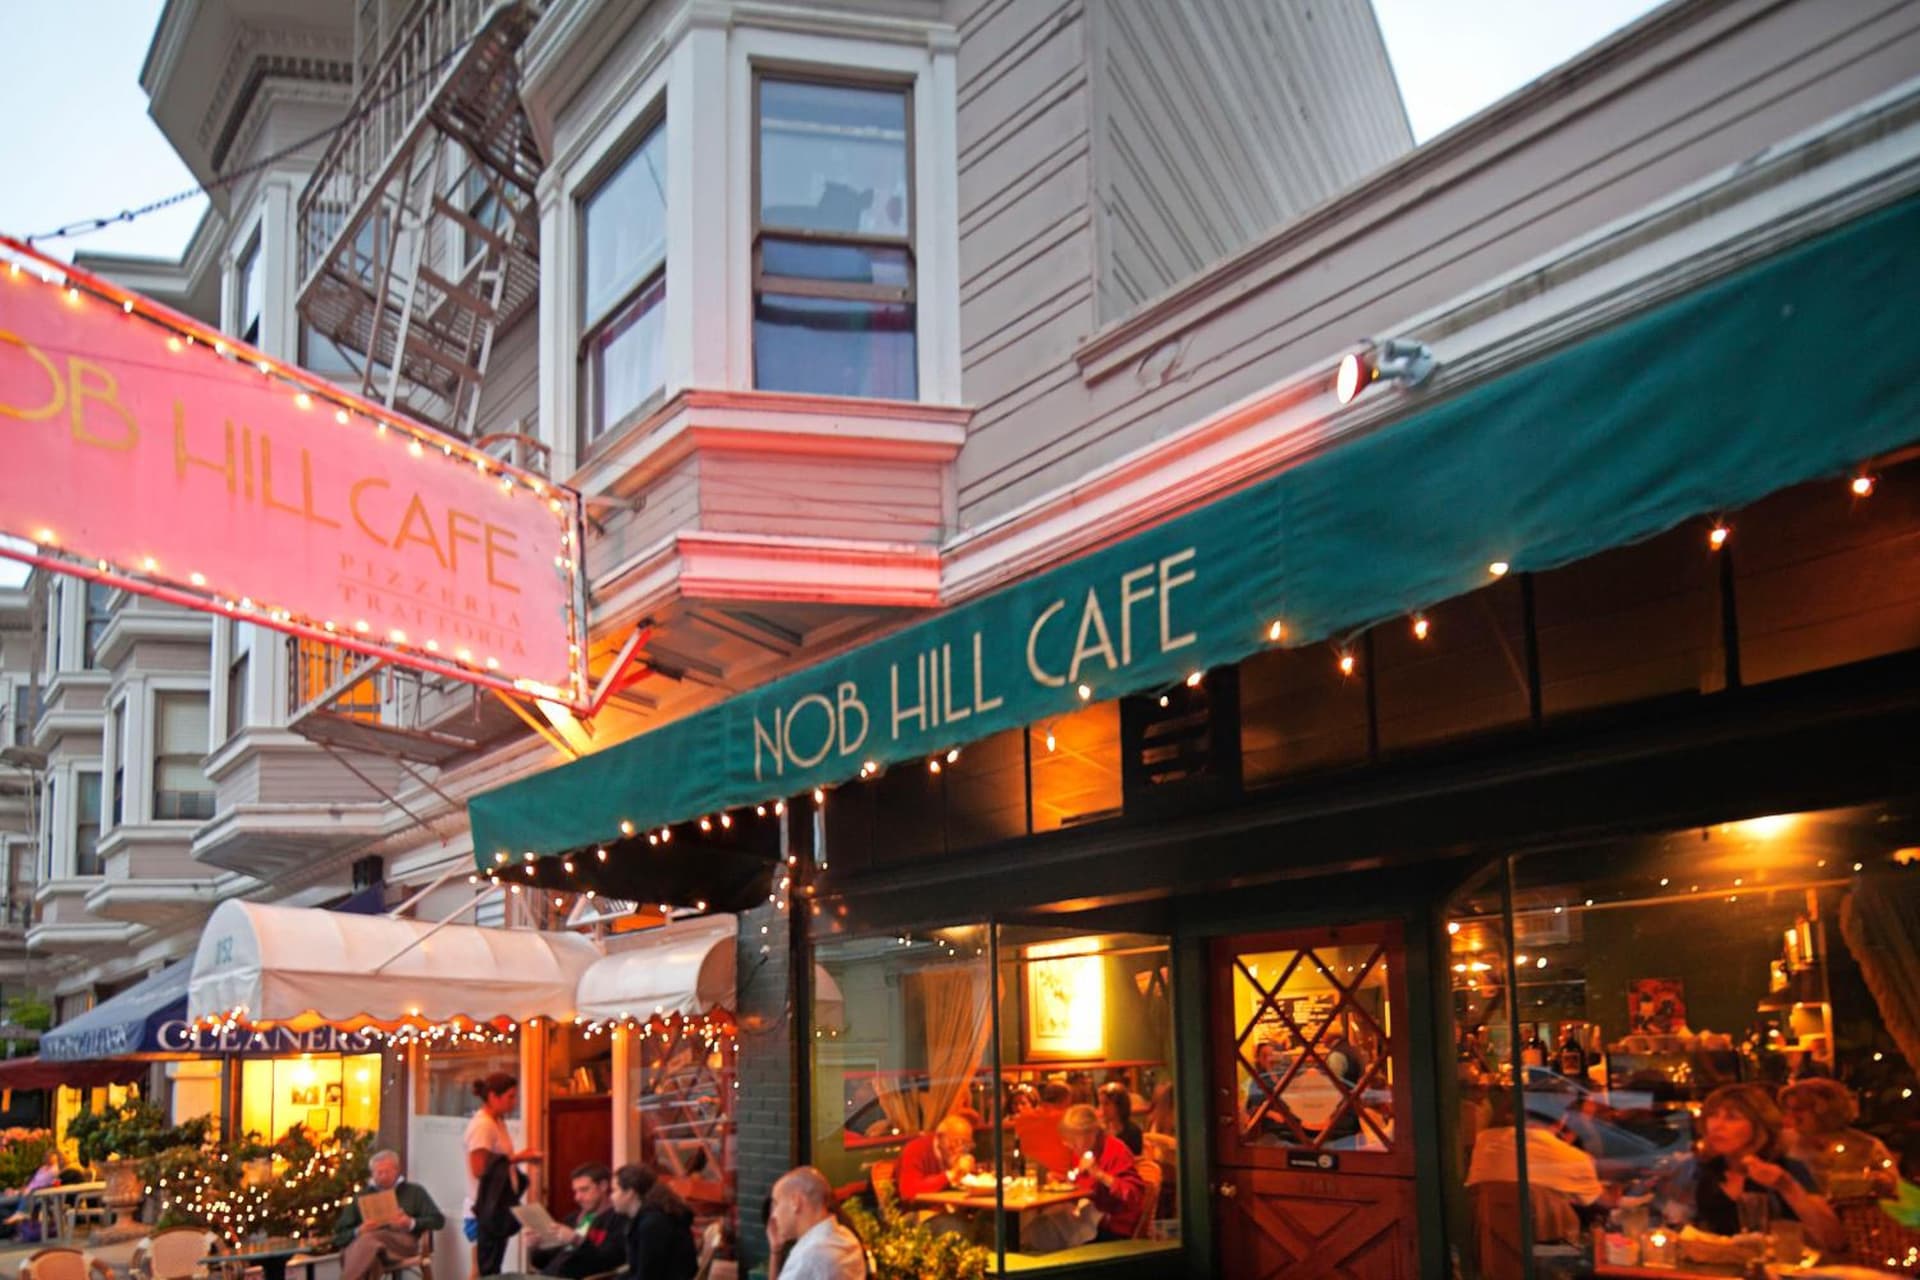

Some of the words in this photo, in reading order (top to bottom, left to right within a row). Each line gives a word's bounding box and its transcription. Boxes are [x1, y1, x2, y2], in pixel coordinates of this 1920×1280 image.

[172, 397, 343, 530] HILL
[348, 477, 522, 595] CAFE
[339, 552, 521, 628] PIZZERIA
[752, 681, 869, 782] NOB
[891, 632, 1003, 740] HILL
[1026, 547, 1197, 688] CAFE
[156, 1020, 369, 1051] CLEANERS
